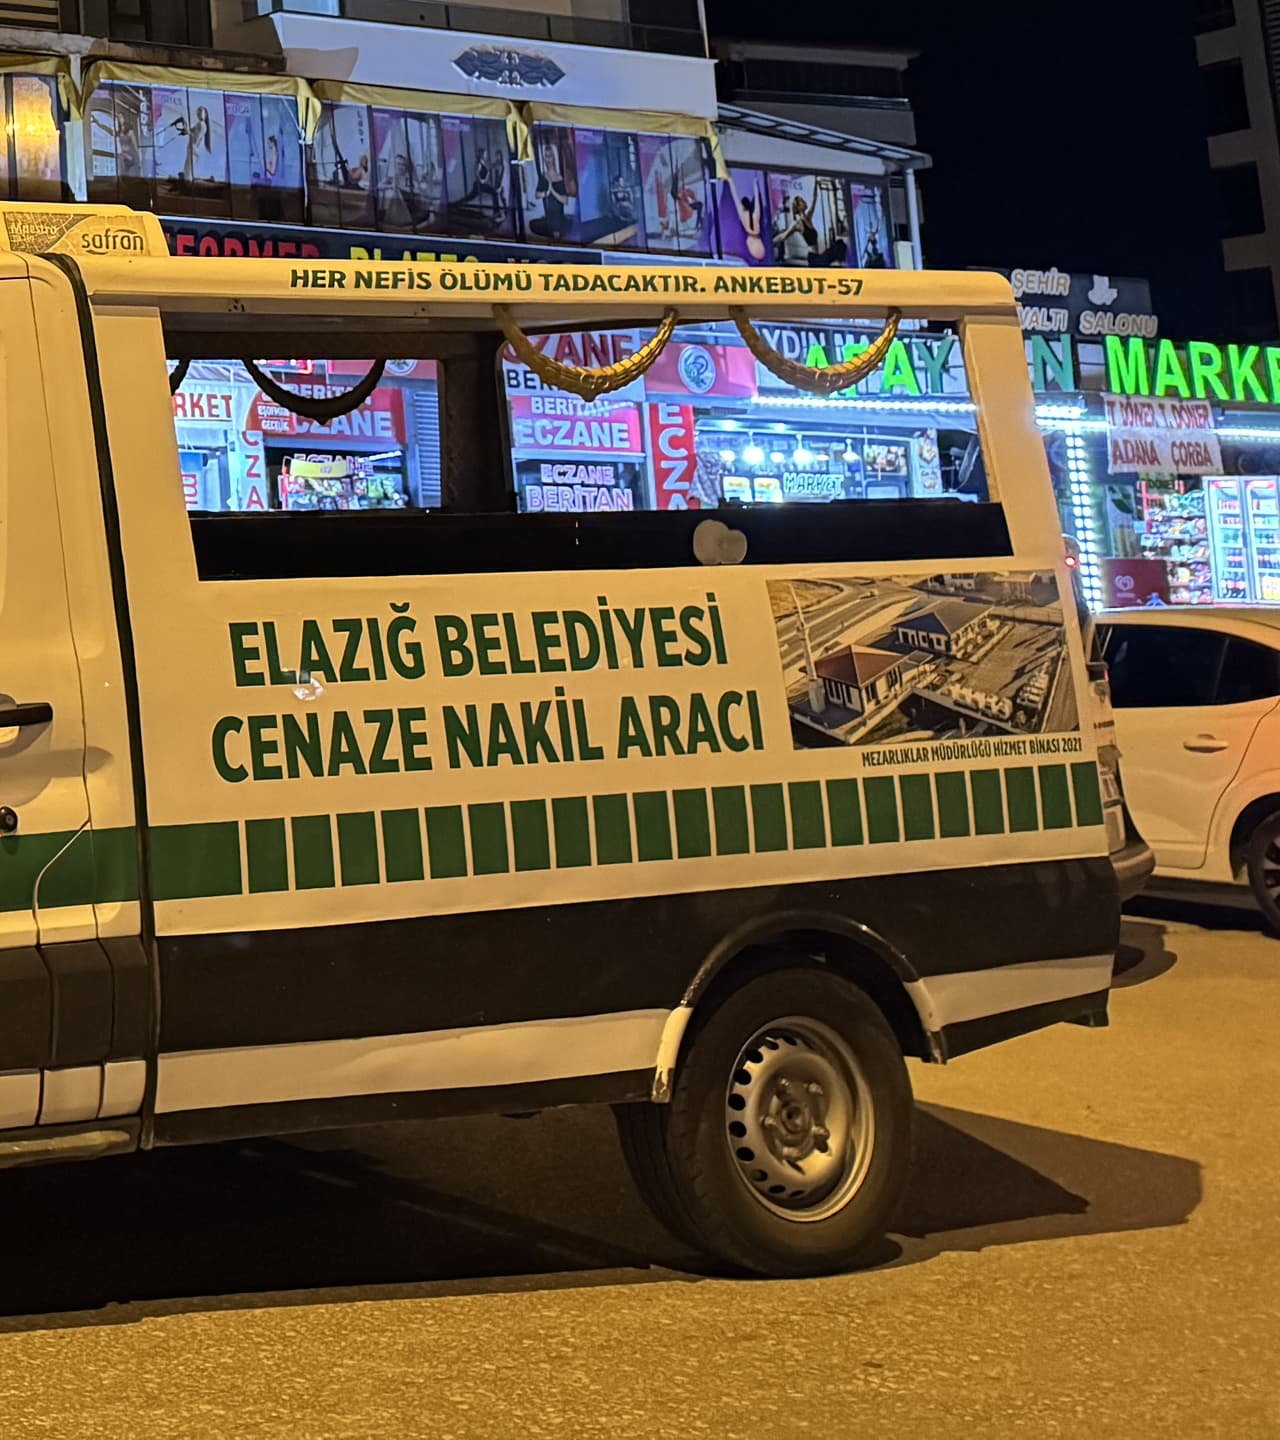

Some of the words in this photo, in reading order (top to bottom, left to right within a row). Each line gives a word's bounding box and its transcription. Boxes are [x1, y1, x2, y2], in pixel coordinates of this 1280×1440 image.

[81, 228, 144, 254] safran
[290, 268, 346, 290] HER
[354, 266, 432, 291] NEFİS
[439, 266, 532, 293] ÖLÜMÜ
[539, 271, 707, 295] TADACAKTIR.
[713, 273, 864, 297] ANKEBUT-57
[1011, 267, 1071, 297] ŞEHİR
[1017, 306, 1069, 333] VALTI
[1079, 311, 1159, 338] SALONU
[172, 391, 233, 419] RKET
[514, 418, 631, 449] ECZANE
[657, 402, 691, 510] ECZA
[1111, 439, 1162, 466] ADANA
[783, 472, 845, 496] MARKET
[227, 601, 427, 688] ELAZIĞ
[432, 591, 729, 679] BELEDİYESİ
[211, 706, 434, 785] CENAZE
[443, 685, 608, 770] NAKİL
[615, 690, 765, 761] ARACI
[993, 737, 1027, 758] HİZMET
[1029, 736, 1060, 756] BİNASI
[1062, 737, 1083, 753] 2021
